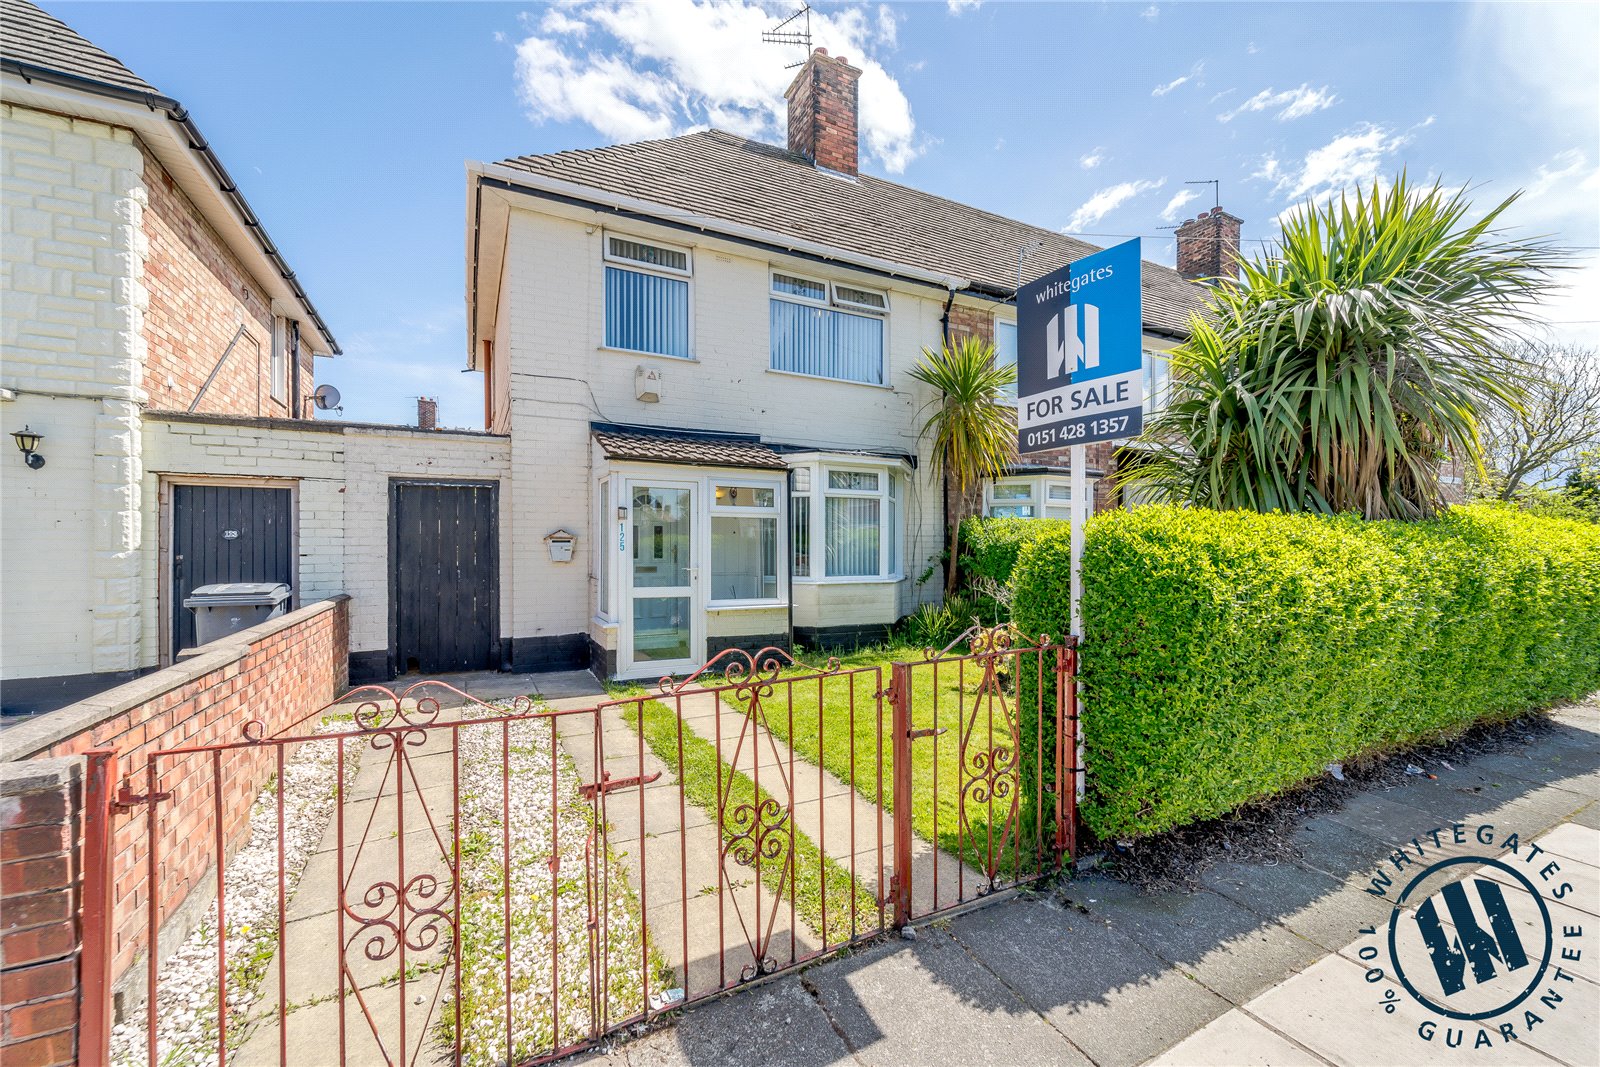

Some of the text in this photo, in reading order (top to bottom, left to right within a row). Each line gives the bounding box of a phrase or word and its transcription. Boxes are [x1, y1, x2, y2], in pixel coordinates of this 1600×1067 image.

[1035, 264, 1114, 304] whitegates
[1027, 380, 1129, 421] FOR SALE
[1027, 416, 1129, 447] 0151 428 1357
